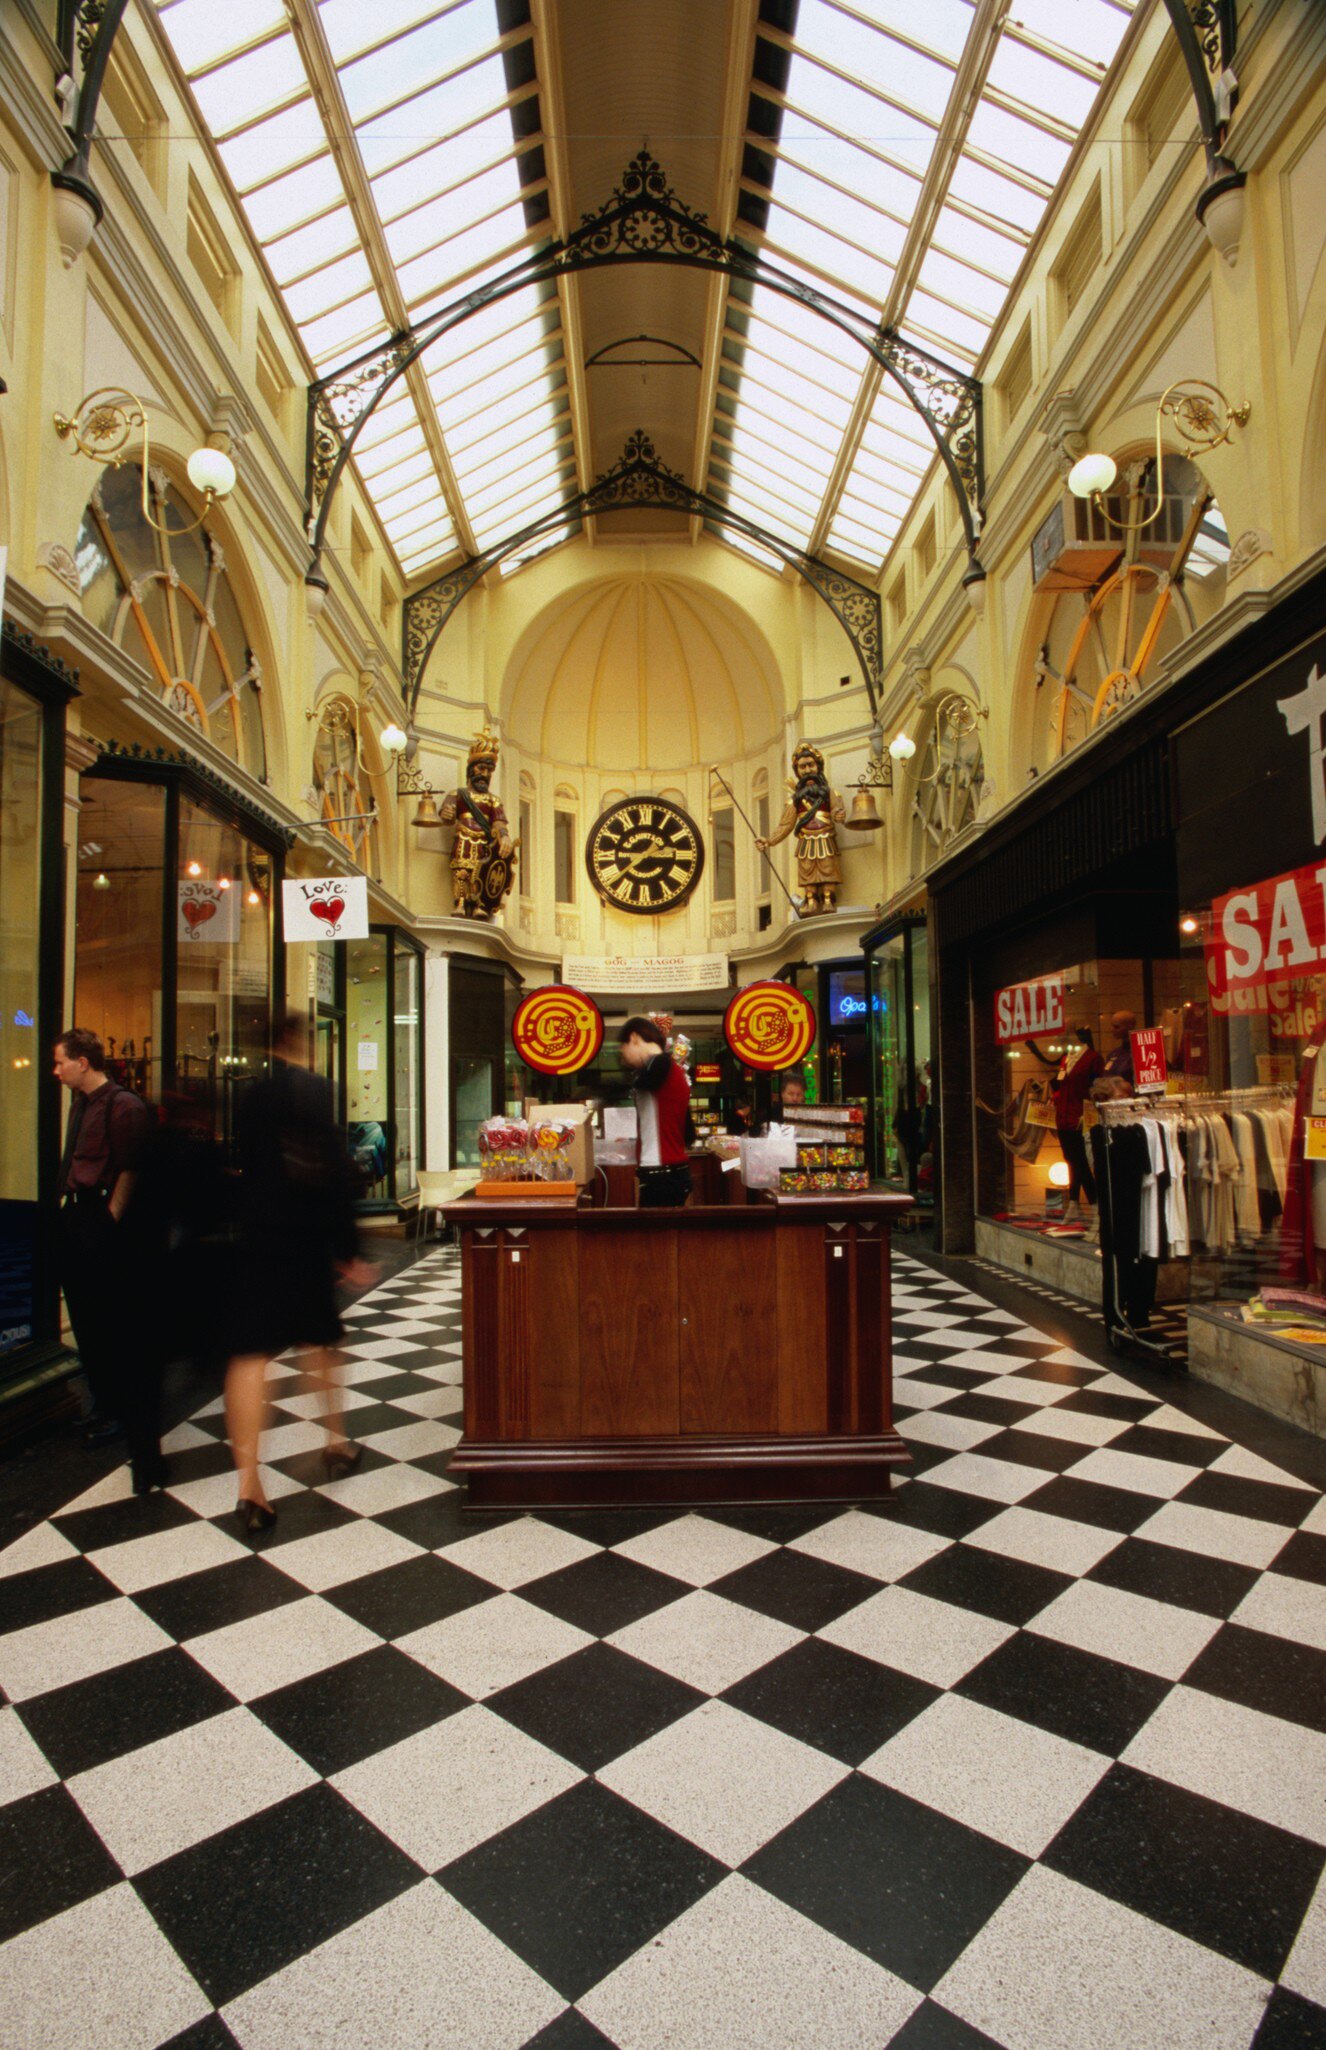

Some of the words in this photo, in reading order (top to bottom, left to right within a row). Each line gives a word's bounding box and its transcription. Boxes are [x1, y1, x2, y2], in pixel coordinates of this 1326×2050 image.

[618, 811, 634, 832] XI
[638, 808, 653, 825] XII
[658, 814, 670, 829] I
[603, 829, 620, 843] X
[670, 829, 688, 843] II
[596, 850, 615, 861] IX
[675, 850, 693, 860] III
[616, 878, 634, 899] VII
[638, 885, 651, 902] VI
[659, 880, 673, 899] V
[1222, 867, 1326, 980] SA
[604, 958, 627, 966] GOG
[643, 958, 685, 966] MAGOG
[998, 977, 1064, 1040] SALE
[1136, 1031, 1157, 1046] HALF
[1140, 1045, 1158, 1069] 1/2
[1139, 1068, 1162, 1083] PRICE
